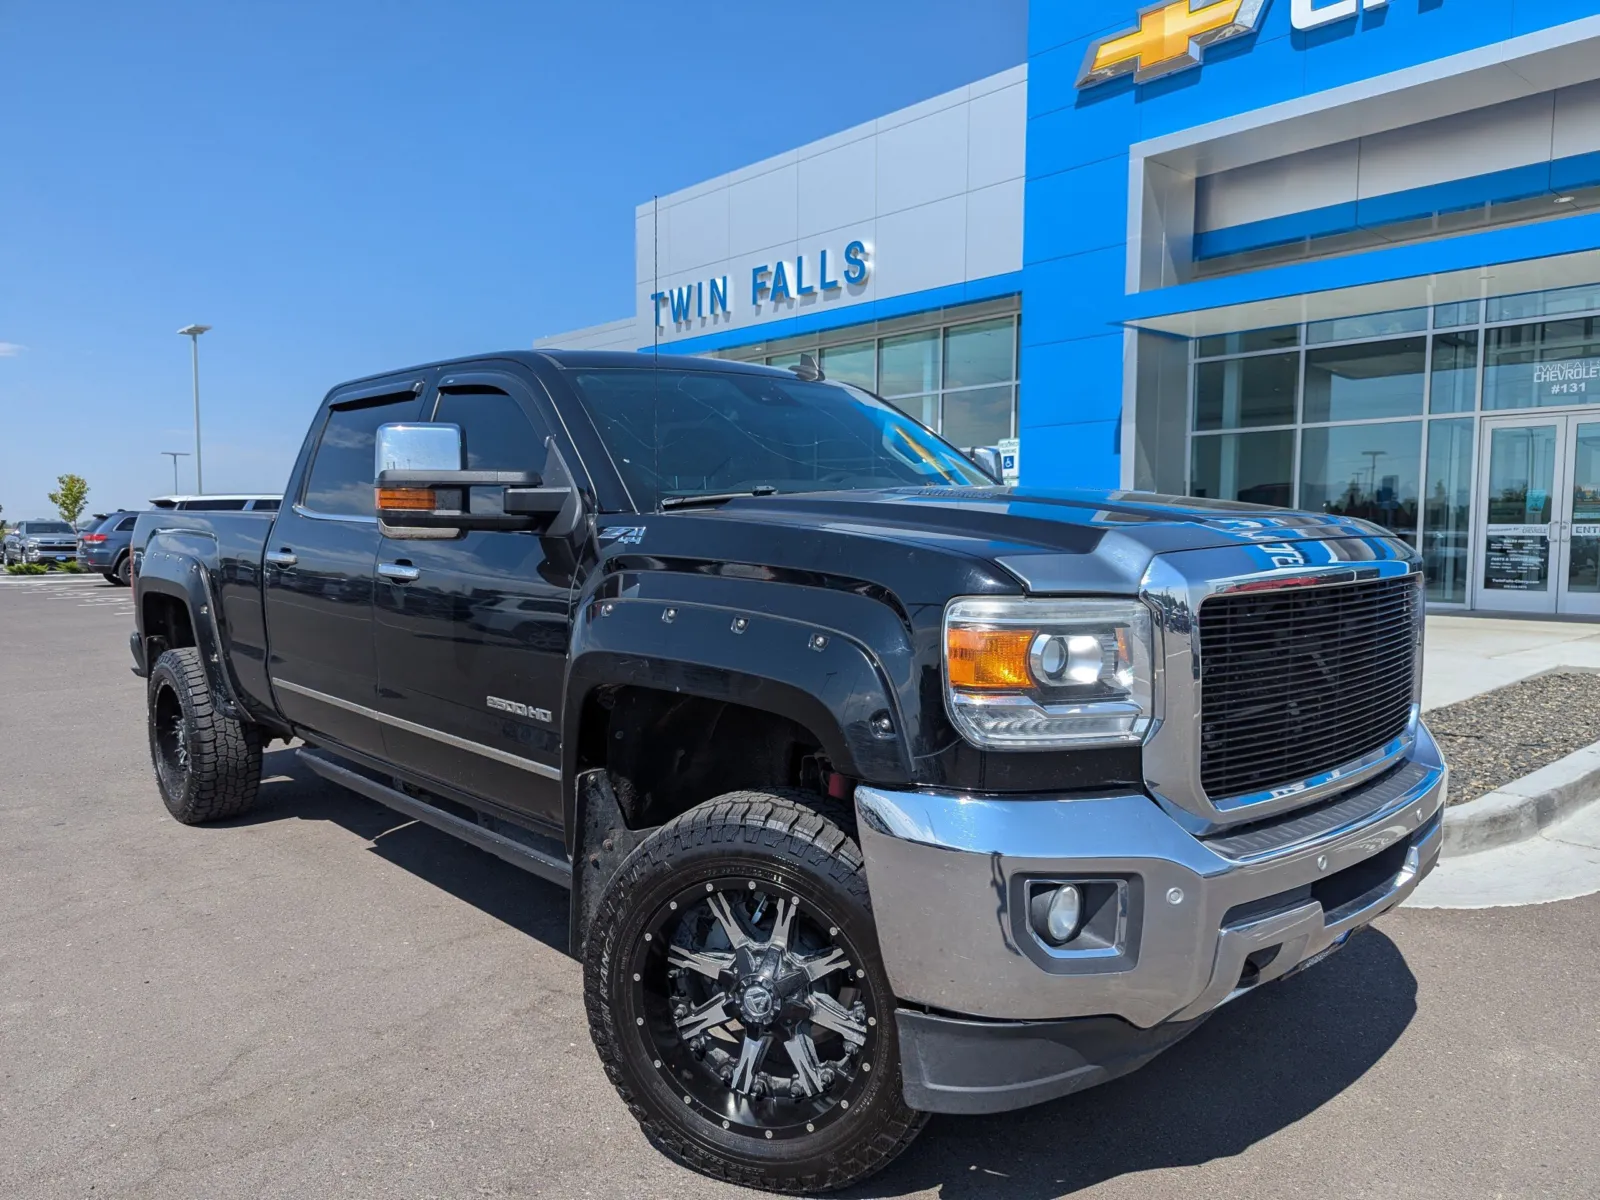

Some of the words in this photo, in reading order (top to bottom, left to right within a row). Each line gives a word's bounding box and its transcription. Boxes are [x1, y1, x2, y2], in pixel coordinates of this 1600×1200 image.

[651, 276, 728, 327] TWIN
[752, 241, 869, 305] FALLS
[1533, 366, 1600, 383] CHEVROLE
[1551, 382, 1586, 394] #131
[1575, 526, 1600, 534] ENT
